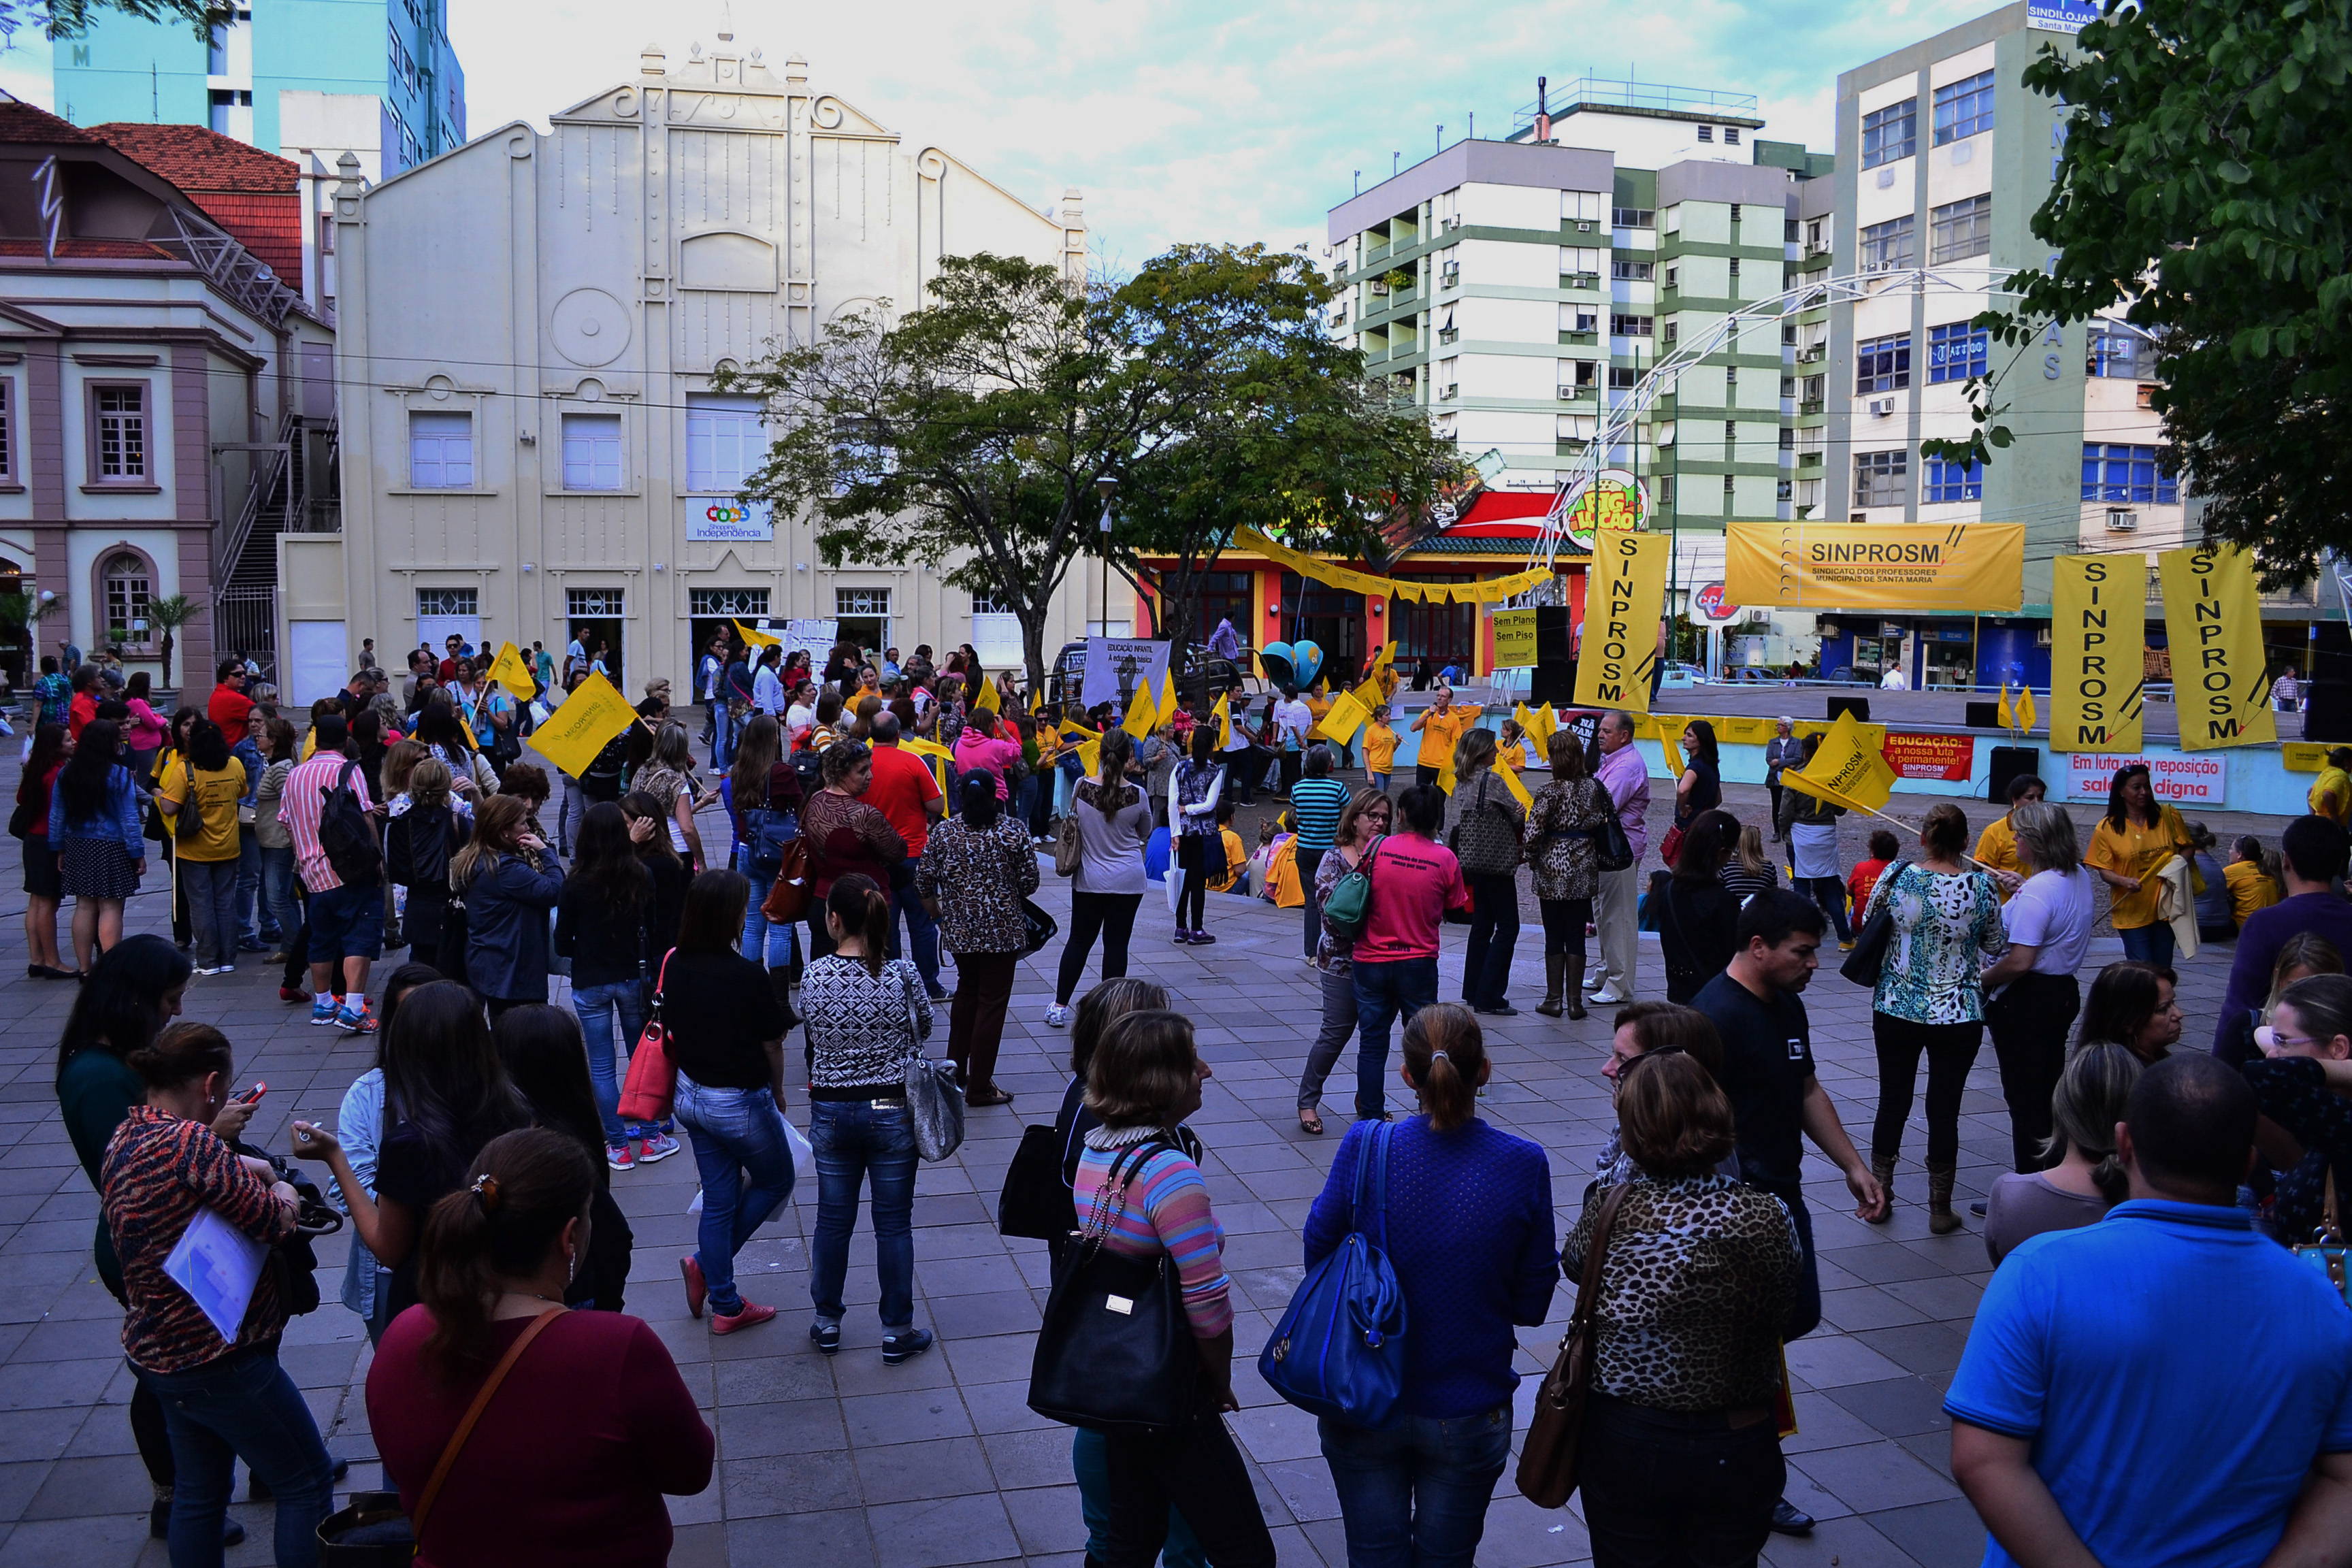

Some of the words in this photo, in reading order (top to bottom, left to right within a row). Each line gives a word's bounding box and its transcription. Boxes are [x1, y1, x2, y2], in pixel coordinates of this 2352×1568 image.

[2029, 6, 2096, 24] SINDILOJAS
[2038, 19, 2062, 31] Santa
[1584, 490, 1627, 512] BIG
[697, 527, 761, 539] Independência
[1811, 542, 1939, 563] SINPROSM
[1812, 567, 1855, 576] SINDICATO
[1857, 568, 1874, 576] DOS
[1876, 568, 1938, 576] PROFESSORES
[1815, 575, 1863, 583] MUNICIPAIS
[1877, 576, 1904, 584] SANTA
[1493, 617, 1511, 626] Sem
[1513, 615, 1536, 625] Plano
[1597, 538, 1638, 702] SINPROSM
[1496, 632, 1514, 640] Sem
[1516, 630, 1534, 639] Piso
[1107, 643, 1133, 653] EDUCAÇÃO
[1134, 645, 1154, 653] INFANTIL
[2190, 553, 2240, 740] SINPROSM
[1108, 654, 1113, 662] A
[1137, 655, 1153, 664] básica
[1311, 654, 1318, 664] oi
[2078, 562, 2108, 745] SINPROSM
[1889, 736, 1963, 748] EDUCAÇÃO:
[1904, 747, 1934, 755] nossa
[1938, 747, 1954, 756] luta
[1889, 753, 1895, 762] é
[1897, 755, 1960, 765] permanente!
[1827, 751, 1865, 791] NPROSM
[1902, 764, 1944, 772] SINPROSM
[2072, 755, 2092, 770] Em
[2095, 754, 2120, 770] luta
[2155, 758, 2219, 778] reposição
[2154, 779, 2208, 799] digna
